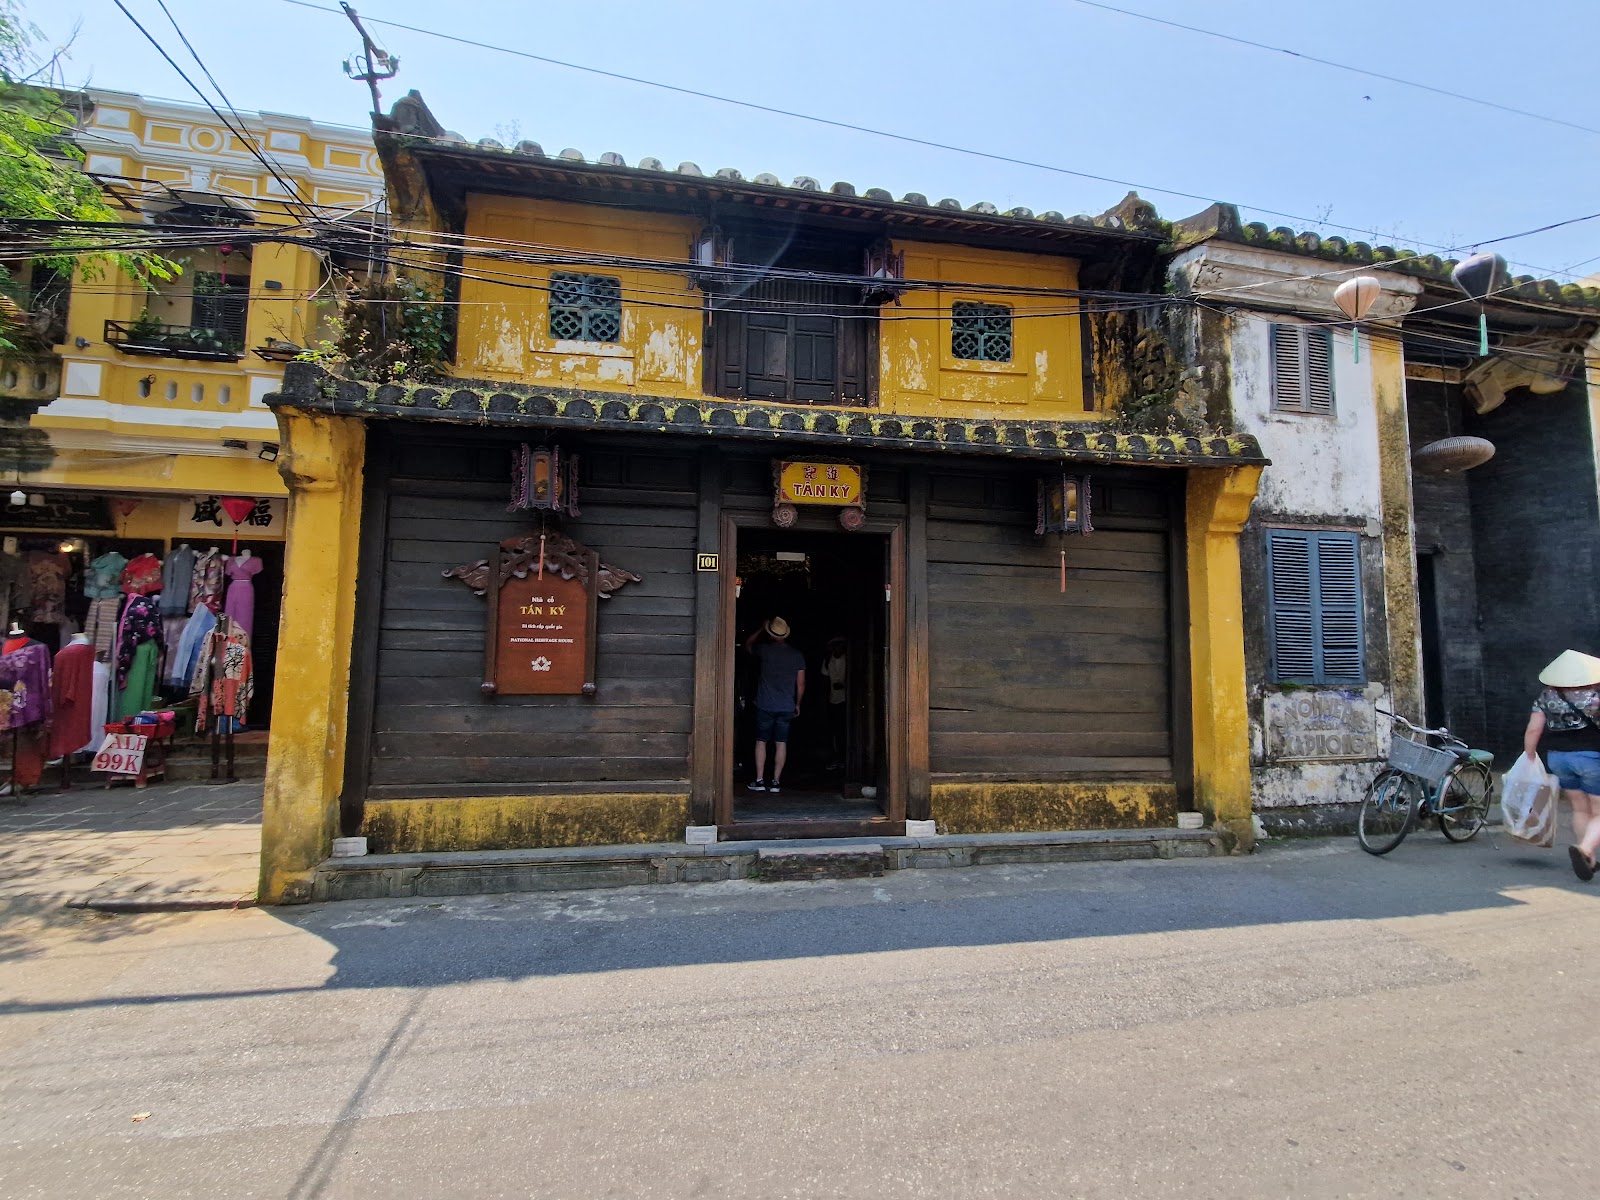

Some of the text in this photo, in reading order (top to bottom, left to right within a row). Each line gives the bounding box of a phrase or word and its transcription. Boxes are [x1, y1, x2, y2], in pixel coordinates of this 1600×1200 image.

[700, 556, 716, 568] 101
[107, 735, 147, 751] ALE
[97, 752, 139, 773] 99K
